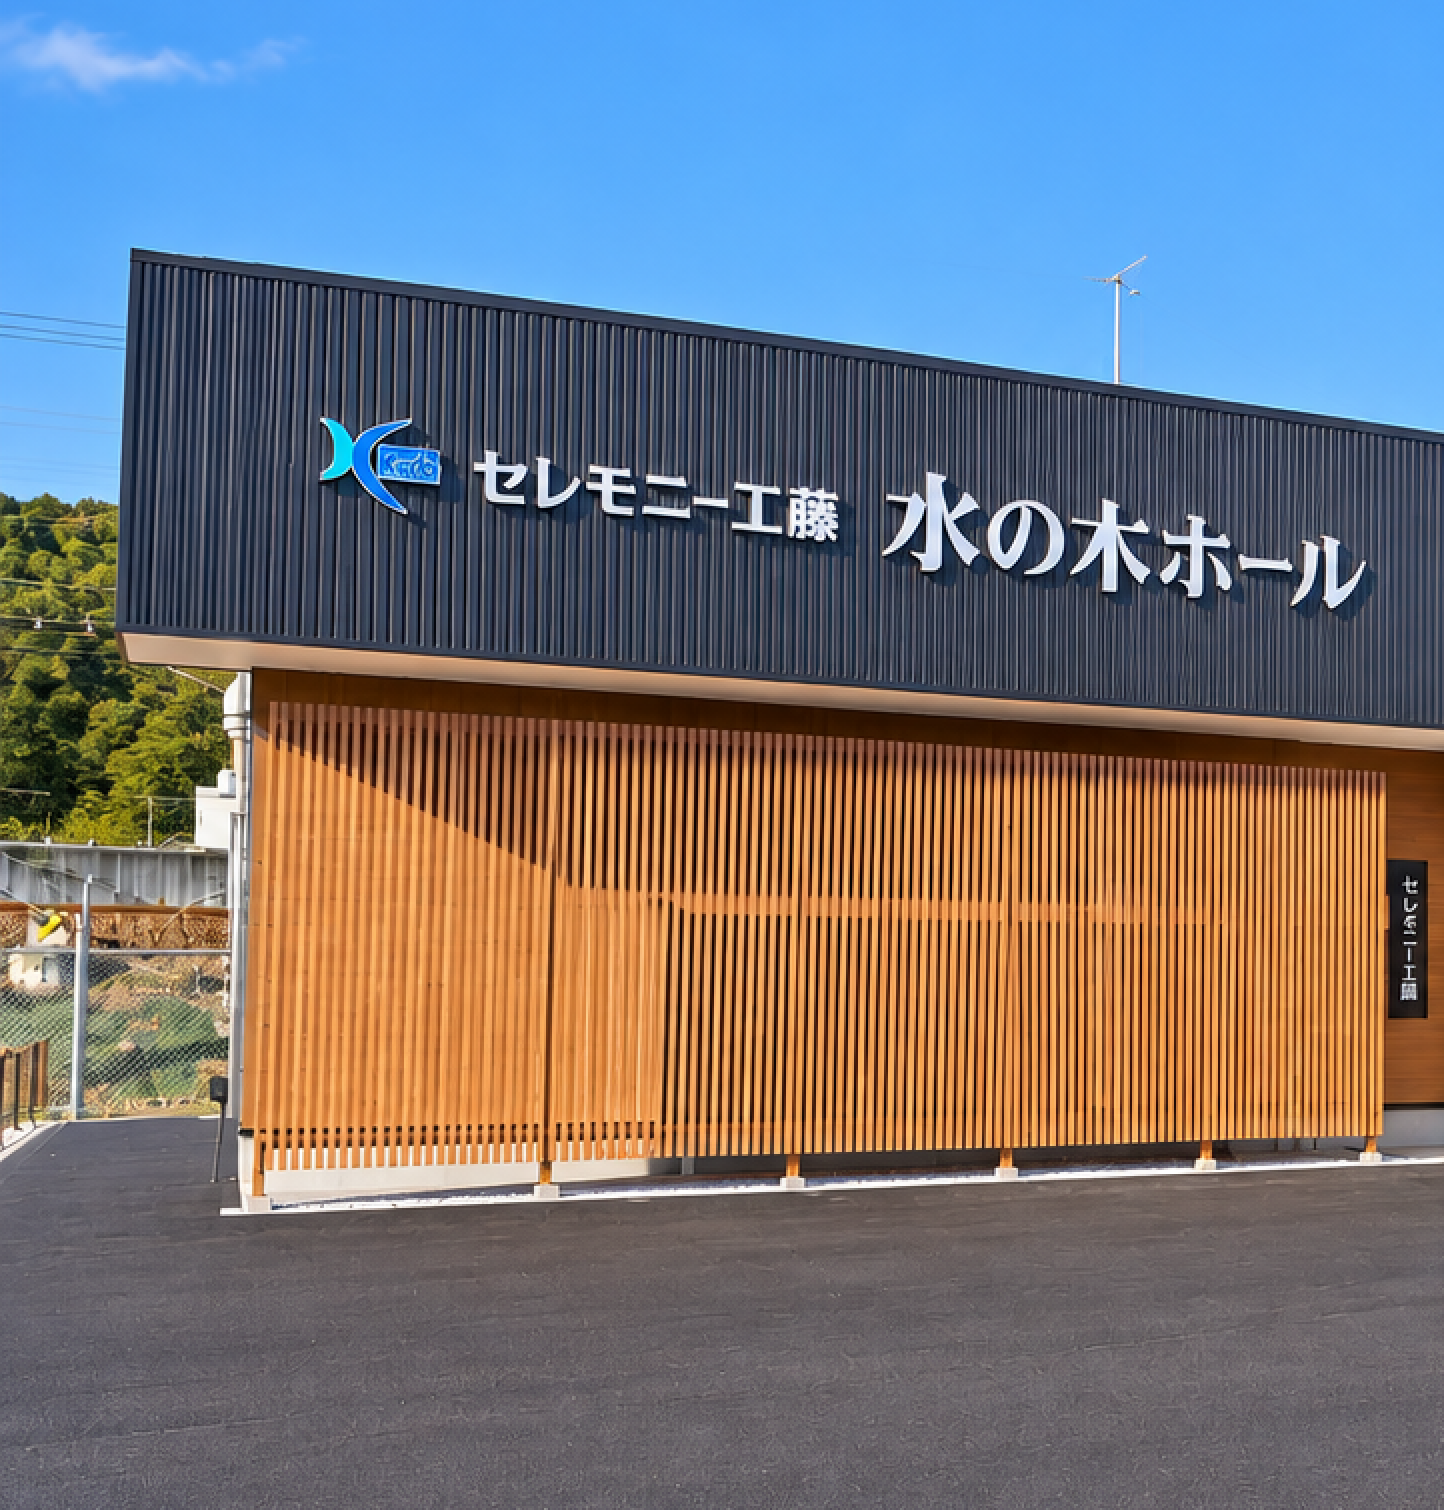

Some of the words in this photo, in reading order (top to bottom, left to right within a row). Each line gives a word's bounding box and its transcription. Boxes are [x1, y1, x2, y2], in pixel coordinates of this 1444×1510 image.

[473, 450, 838, 542] セレモニー工藤
[882, 471, 1366, 609] 水の木ホール
